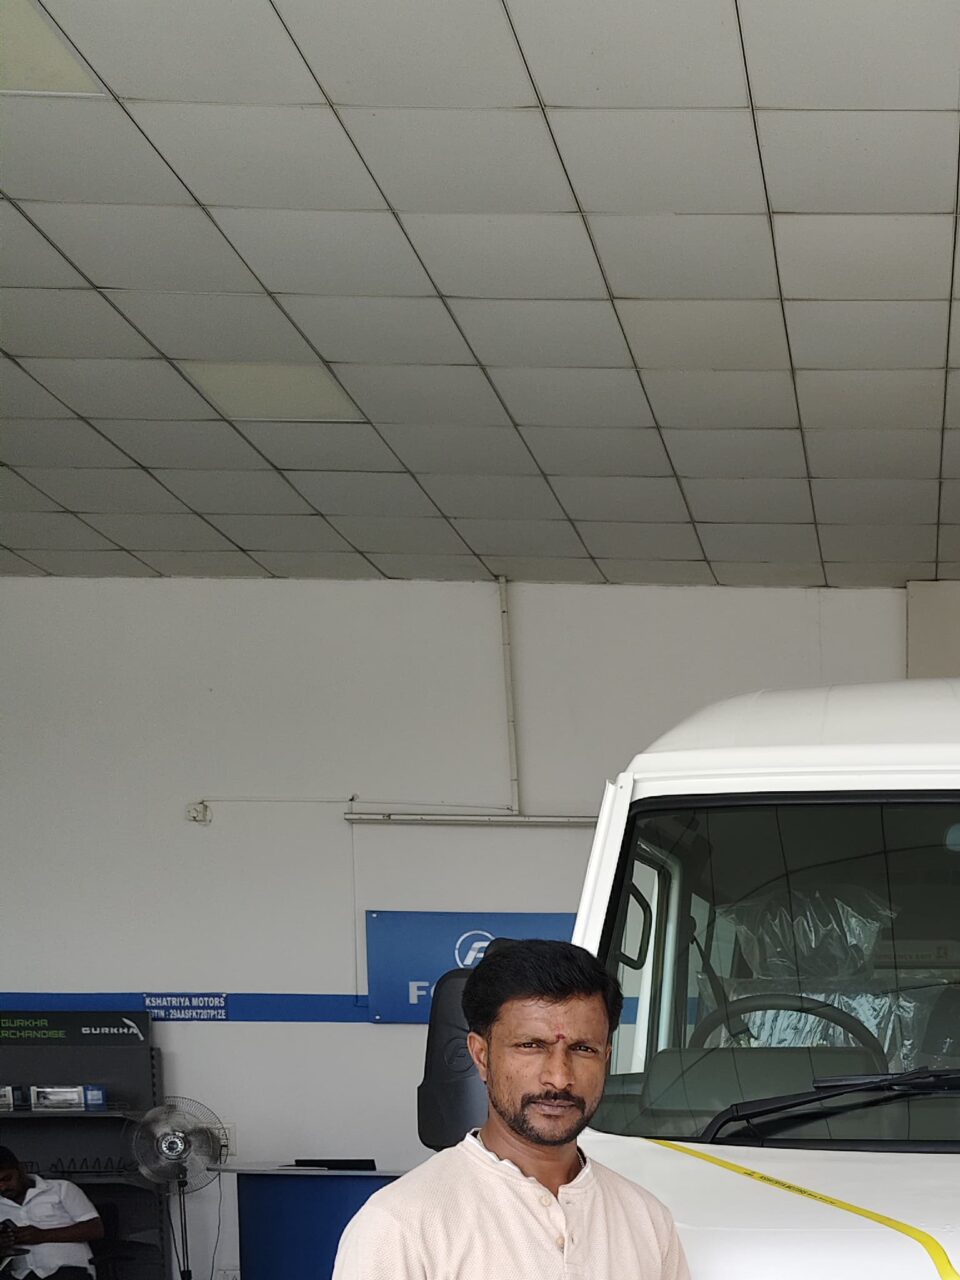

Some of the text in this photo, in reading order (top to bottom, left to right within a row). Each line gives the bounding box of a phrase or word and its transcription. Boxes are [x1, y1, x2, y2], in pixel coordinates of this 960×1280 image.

[145, 997, 225, 1007] KSHATRIYA MOTORS
[1, 1019, 48, 1027] GURKHA
[0, 1030, 66, 1038] RCHANDISE
[81, 1026, 138, 1034] GURKHA
